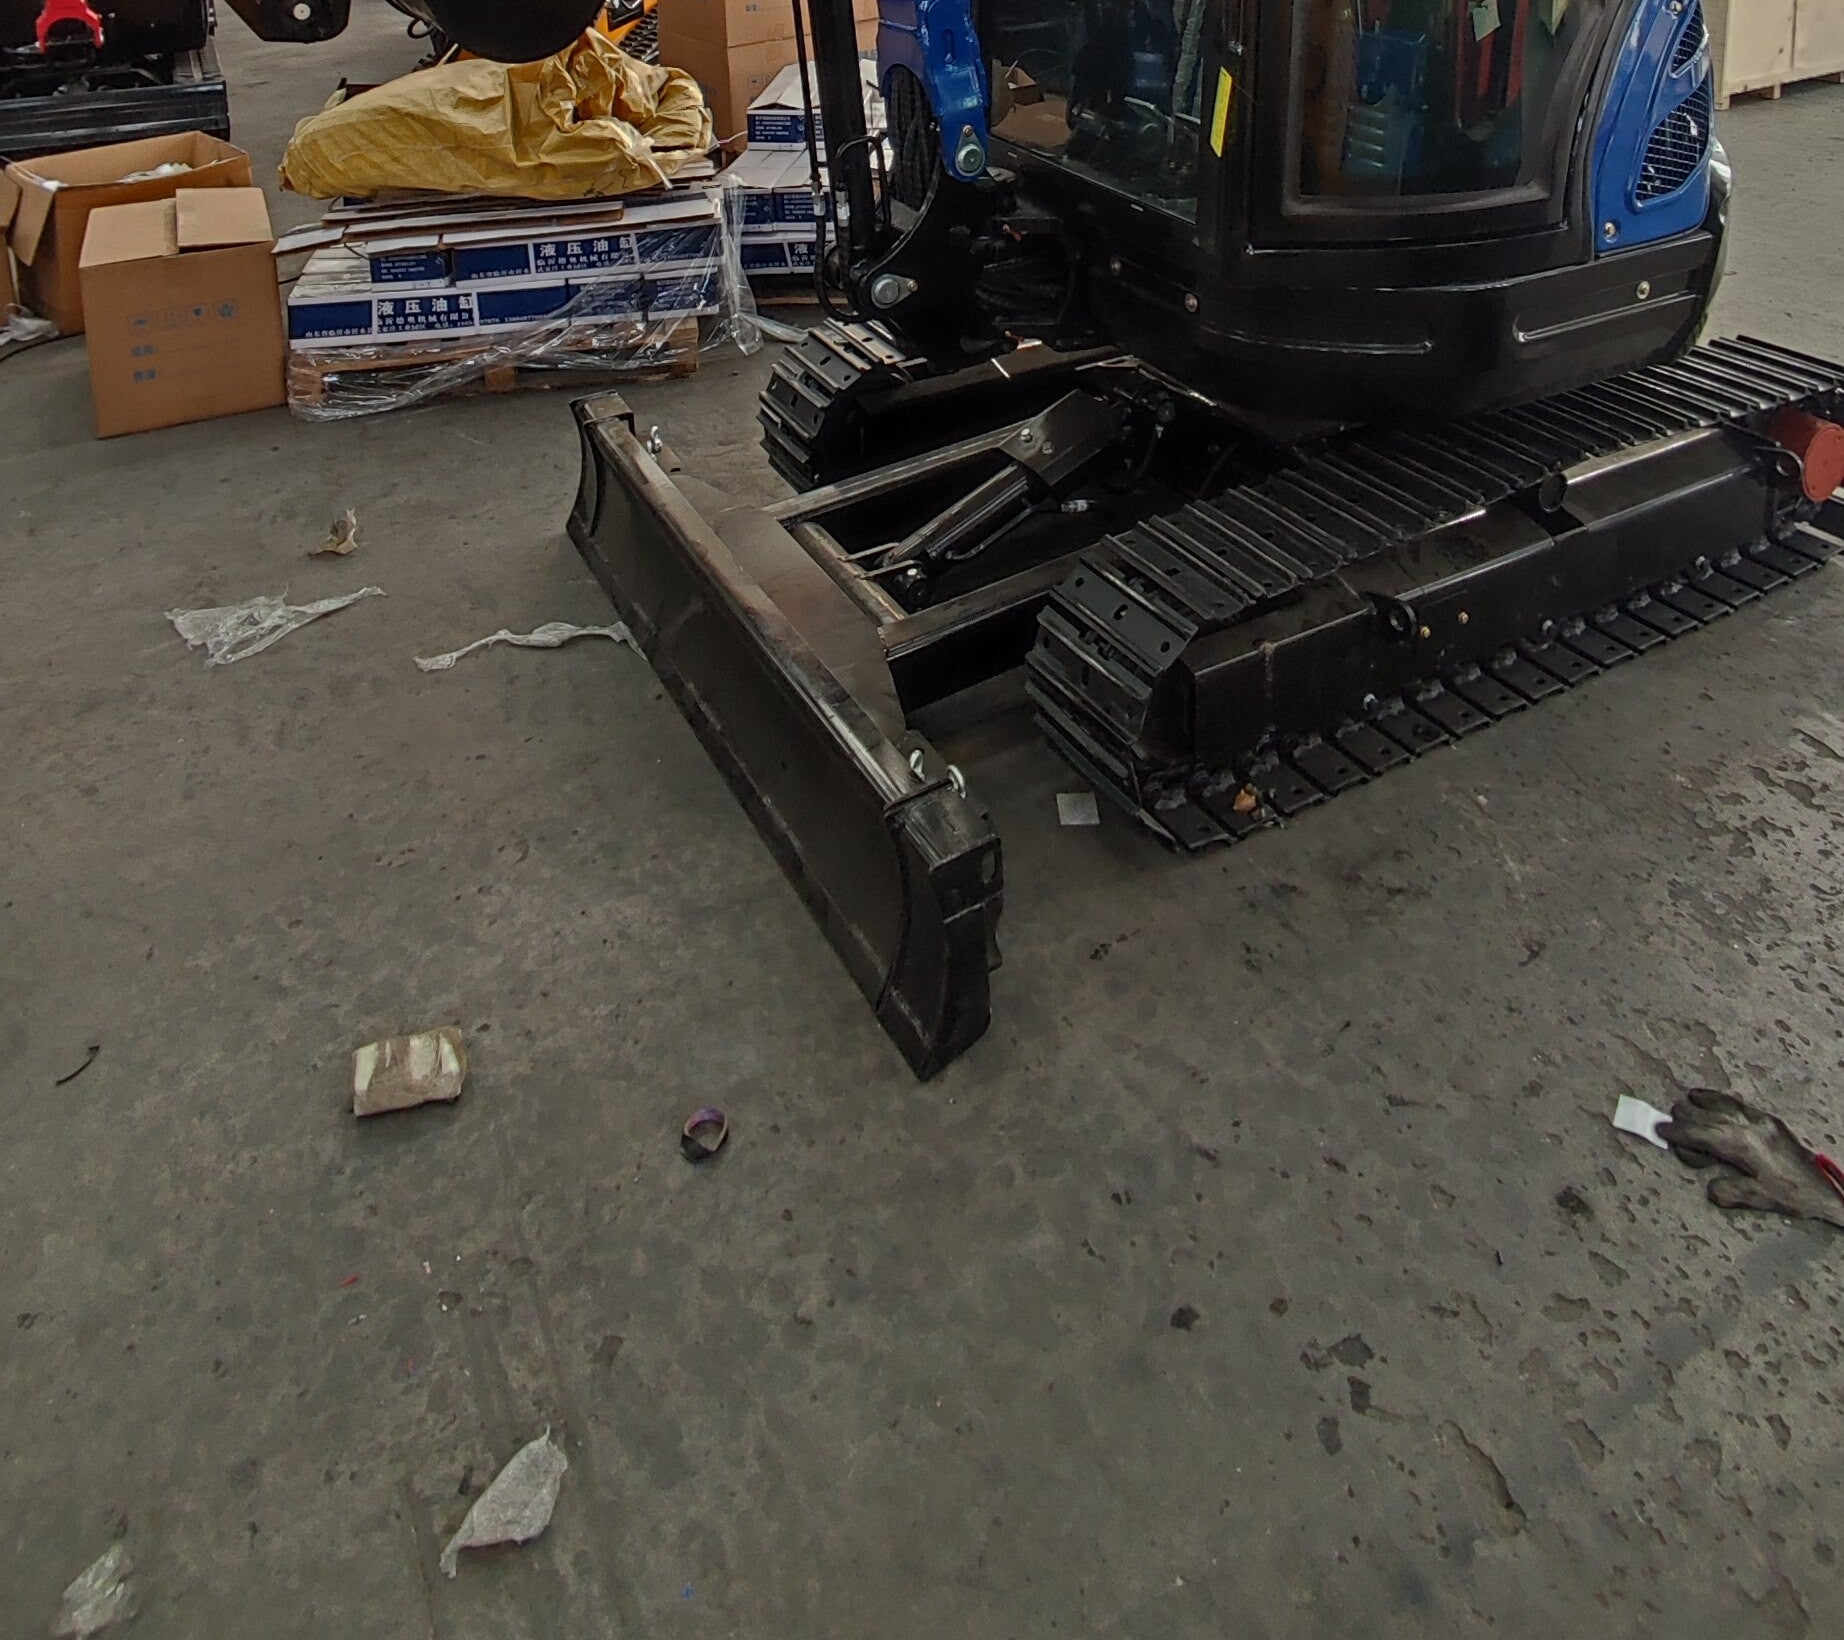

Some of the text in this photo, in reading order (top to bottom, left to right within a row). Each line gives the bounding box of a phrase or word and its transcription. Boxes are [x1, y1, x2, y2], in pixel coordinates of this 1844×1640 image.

[539, 236, 632, 257] 液压油缸
[377, 295, 474, 316] 液压油缸
